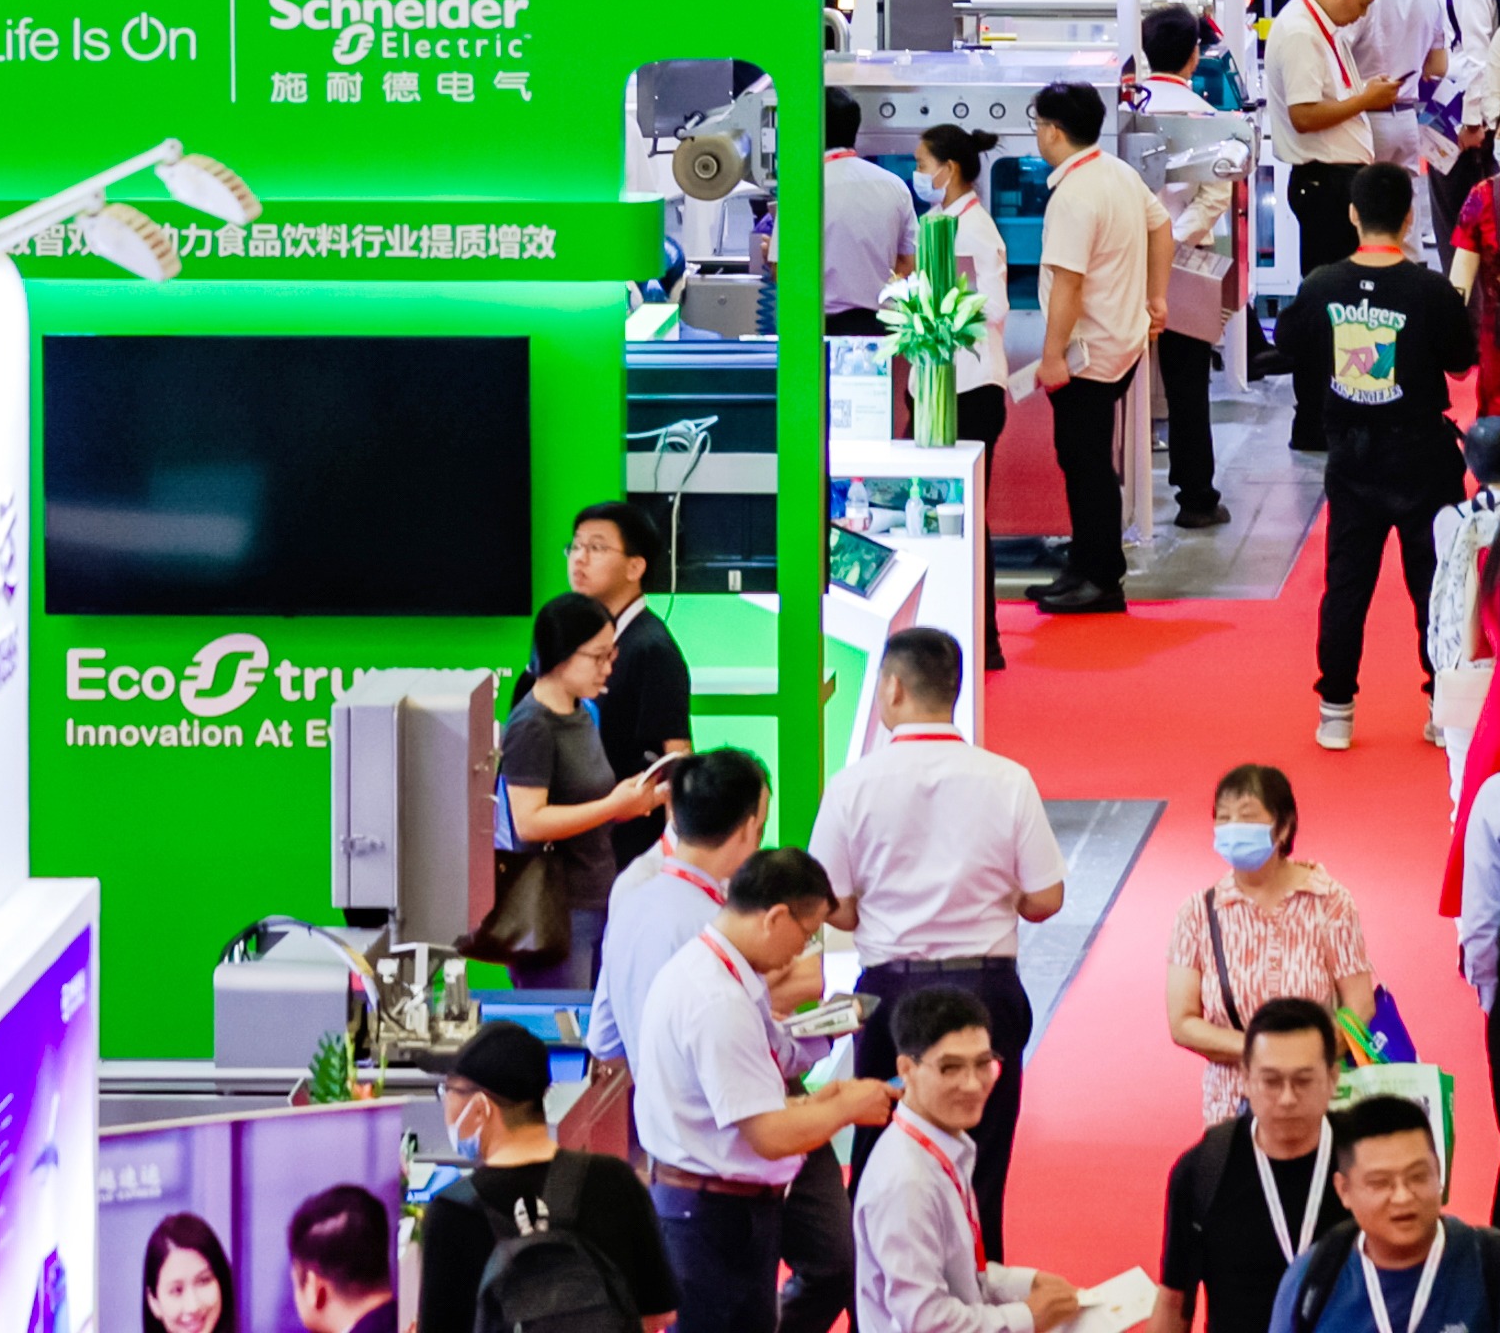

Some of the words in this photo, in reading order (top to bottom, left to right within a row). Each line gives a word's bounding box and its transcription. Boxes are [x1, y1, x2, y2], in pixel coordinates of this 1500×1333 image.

[72, 17, 111, 62] Is
[121, 11, 198, 62] On
[381, 31, 525, 60] Electric
[269, 69, 533, 104] 施耐德电气
[1326, 297, 1407, 332] Dodgers
[1330, 375, 1349, 397] LOS
[65, 718, 244, 750] Innovation
[254, 719, 293, 749] At
